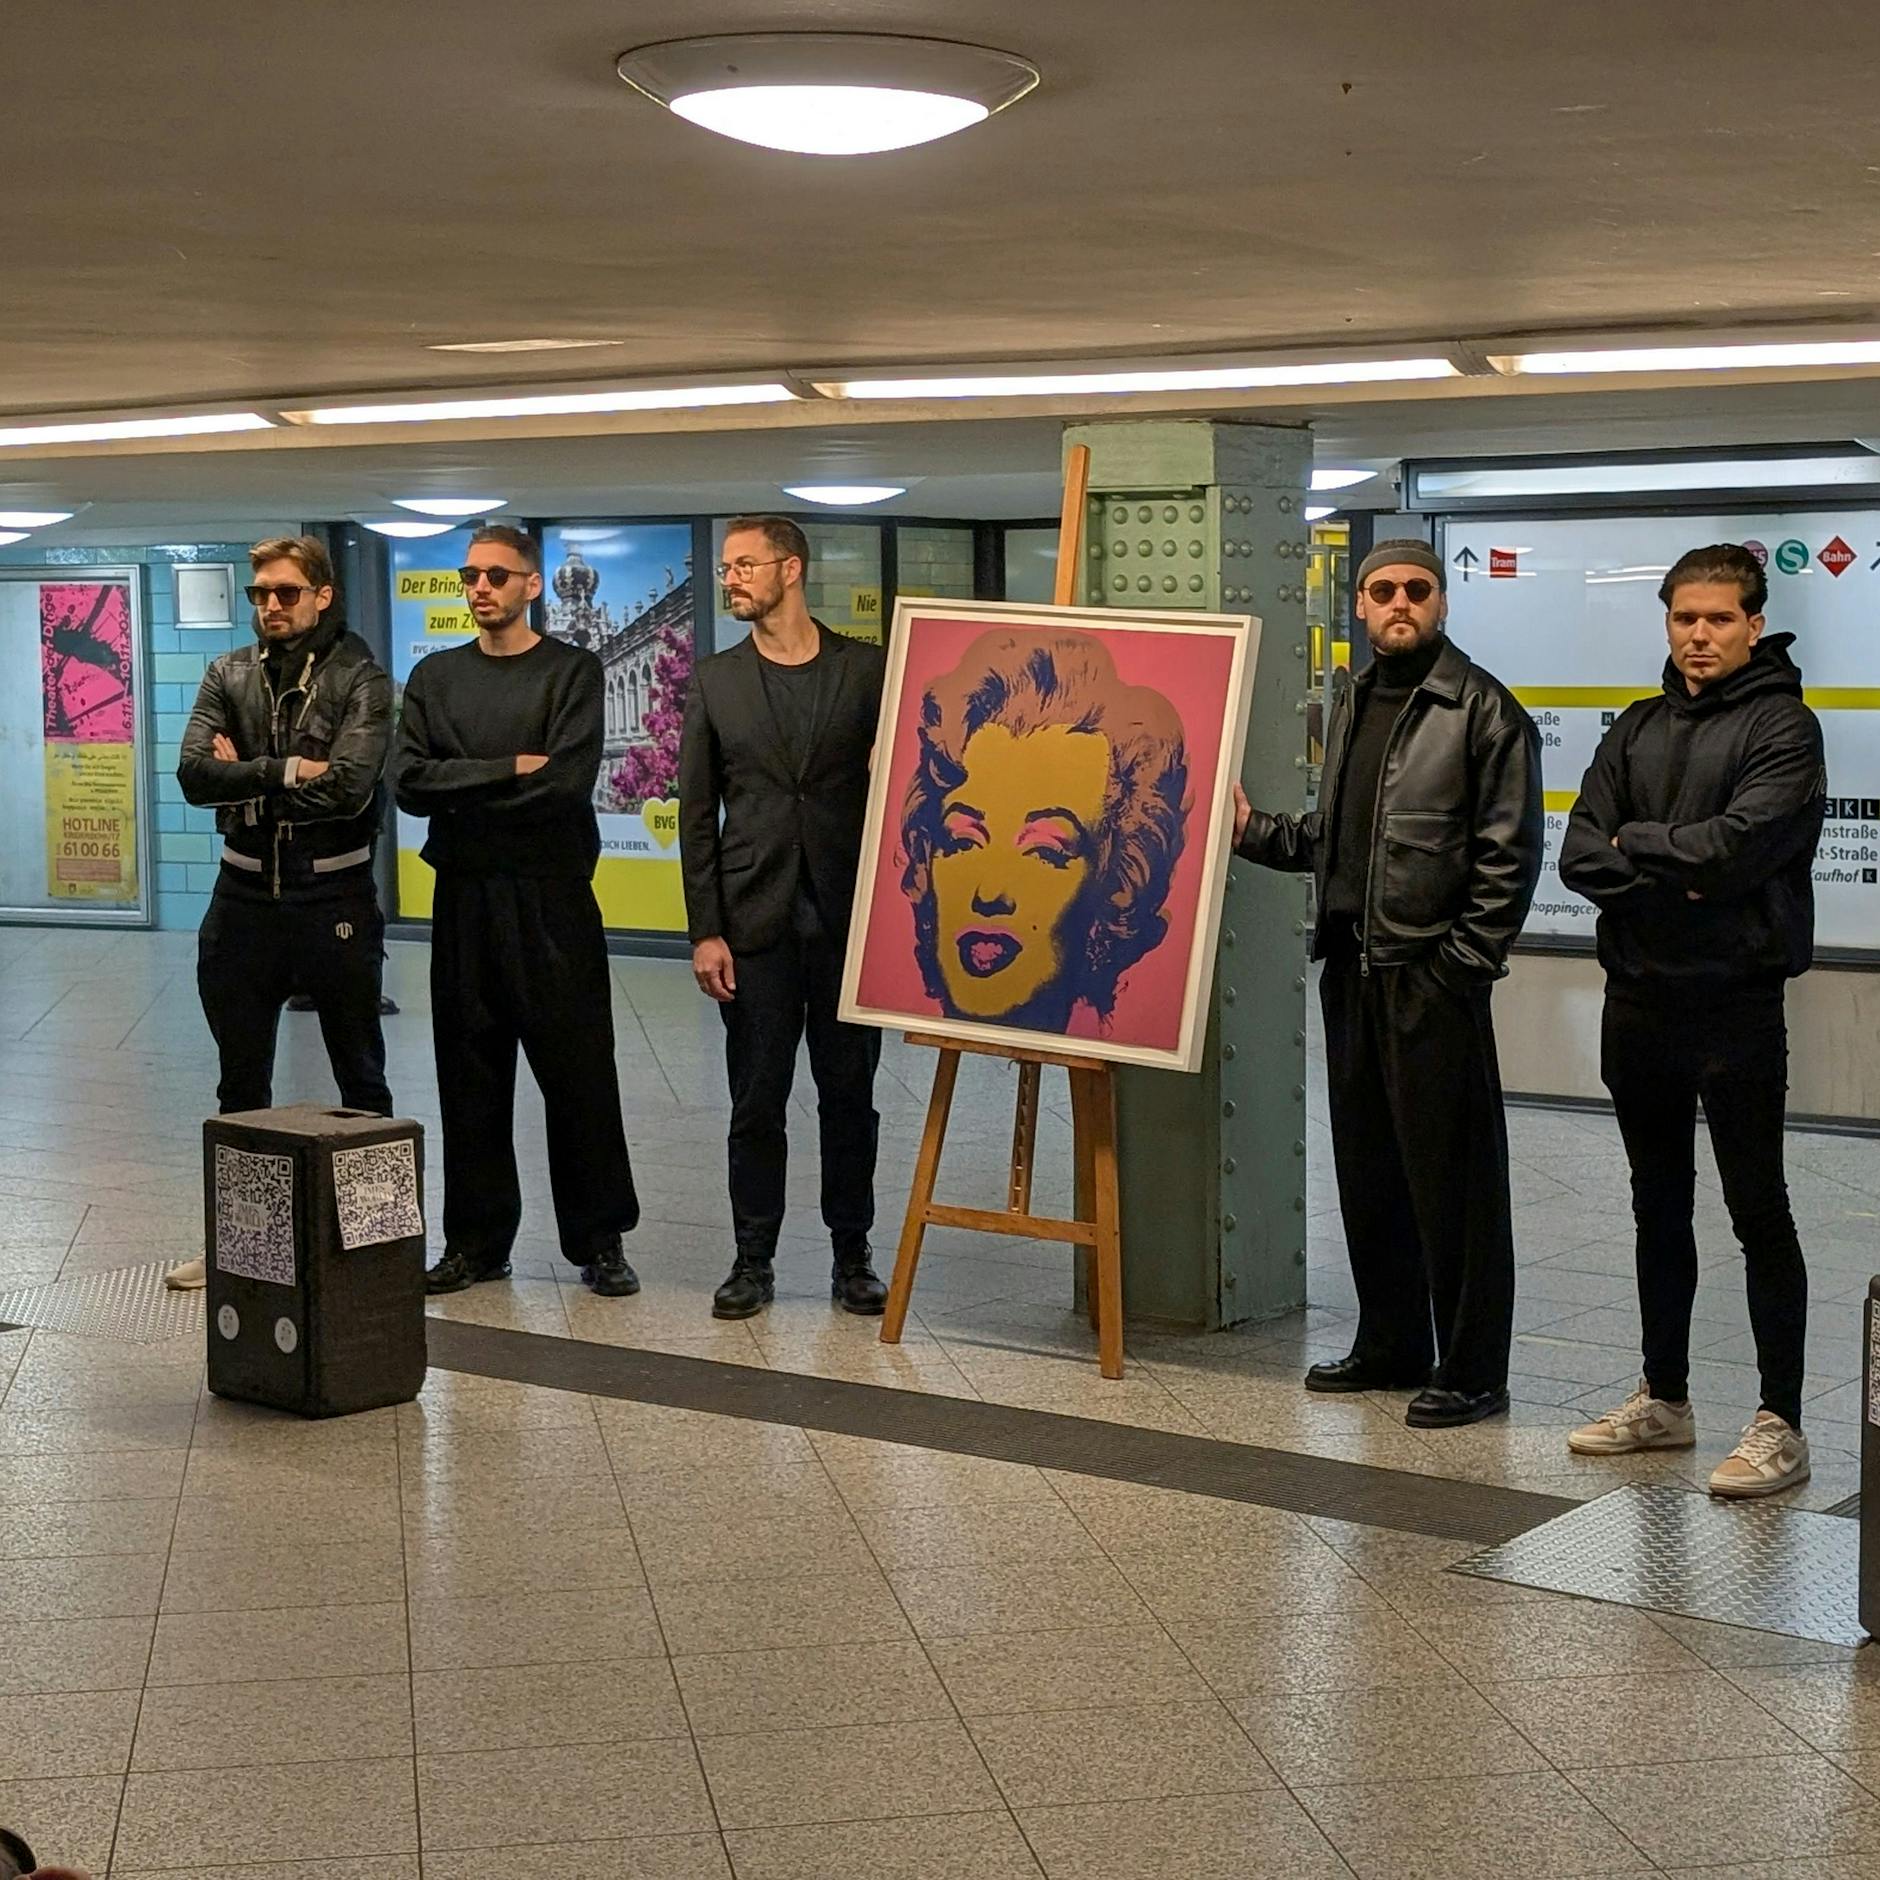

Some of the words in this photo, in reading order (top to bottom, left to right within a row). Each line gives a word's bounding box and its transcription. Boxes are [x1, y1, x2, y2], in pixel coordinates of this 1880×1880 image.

[1491, 556, 1516, 568] Tram
[1822, 551, 1852, 563] Bahn
[401, 577, 426, 594] Der
[856, 594, 877, 612] Nie
[429, 615, 458, 629] zum
[45, 671, 58, 729] Theater
[1843, 800, 1855, 816] K
[63, 817, 120, 832] HOTLINE
[654, 815, 676, 830] BVG
[1822, 824, 1879, 840] nstraße
[63, 841, 78, 856] 61
[81, 842, 99, 857] 00
[102, 842, 120, 857] 66
[1817, 845, 1879, 861] t-Straße
[1812, 868, 1860, 883] aufhof
